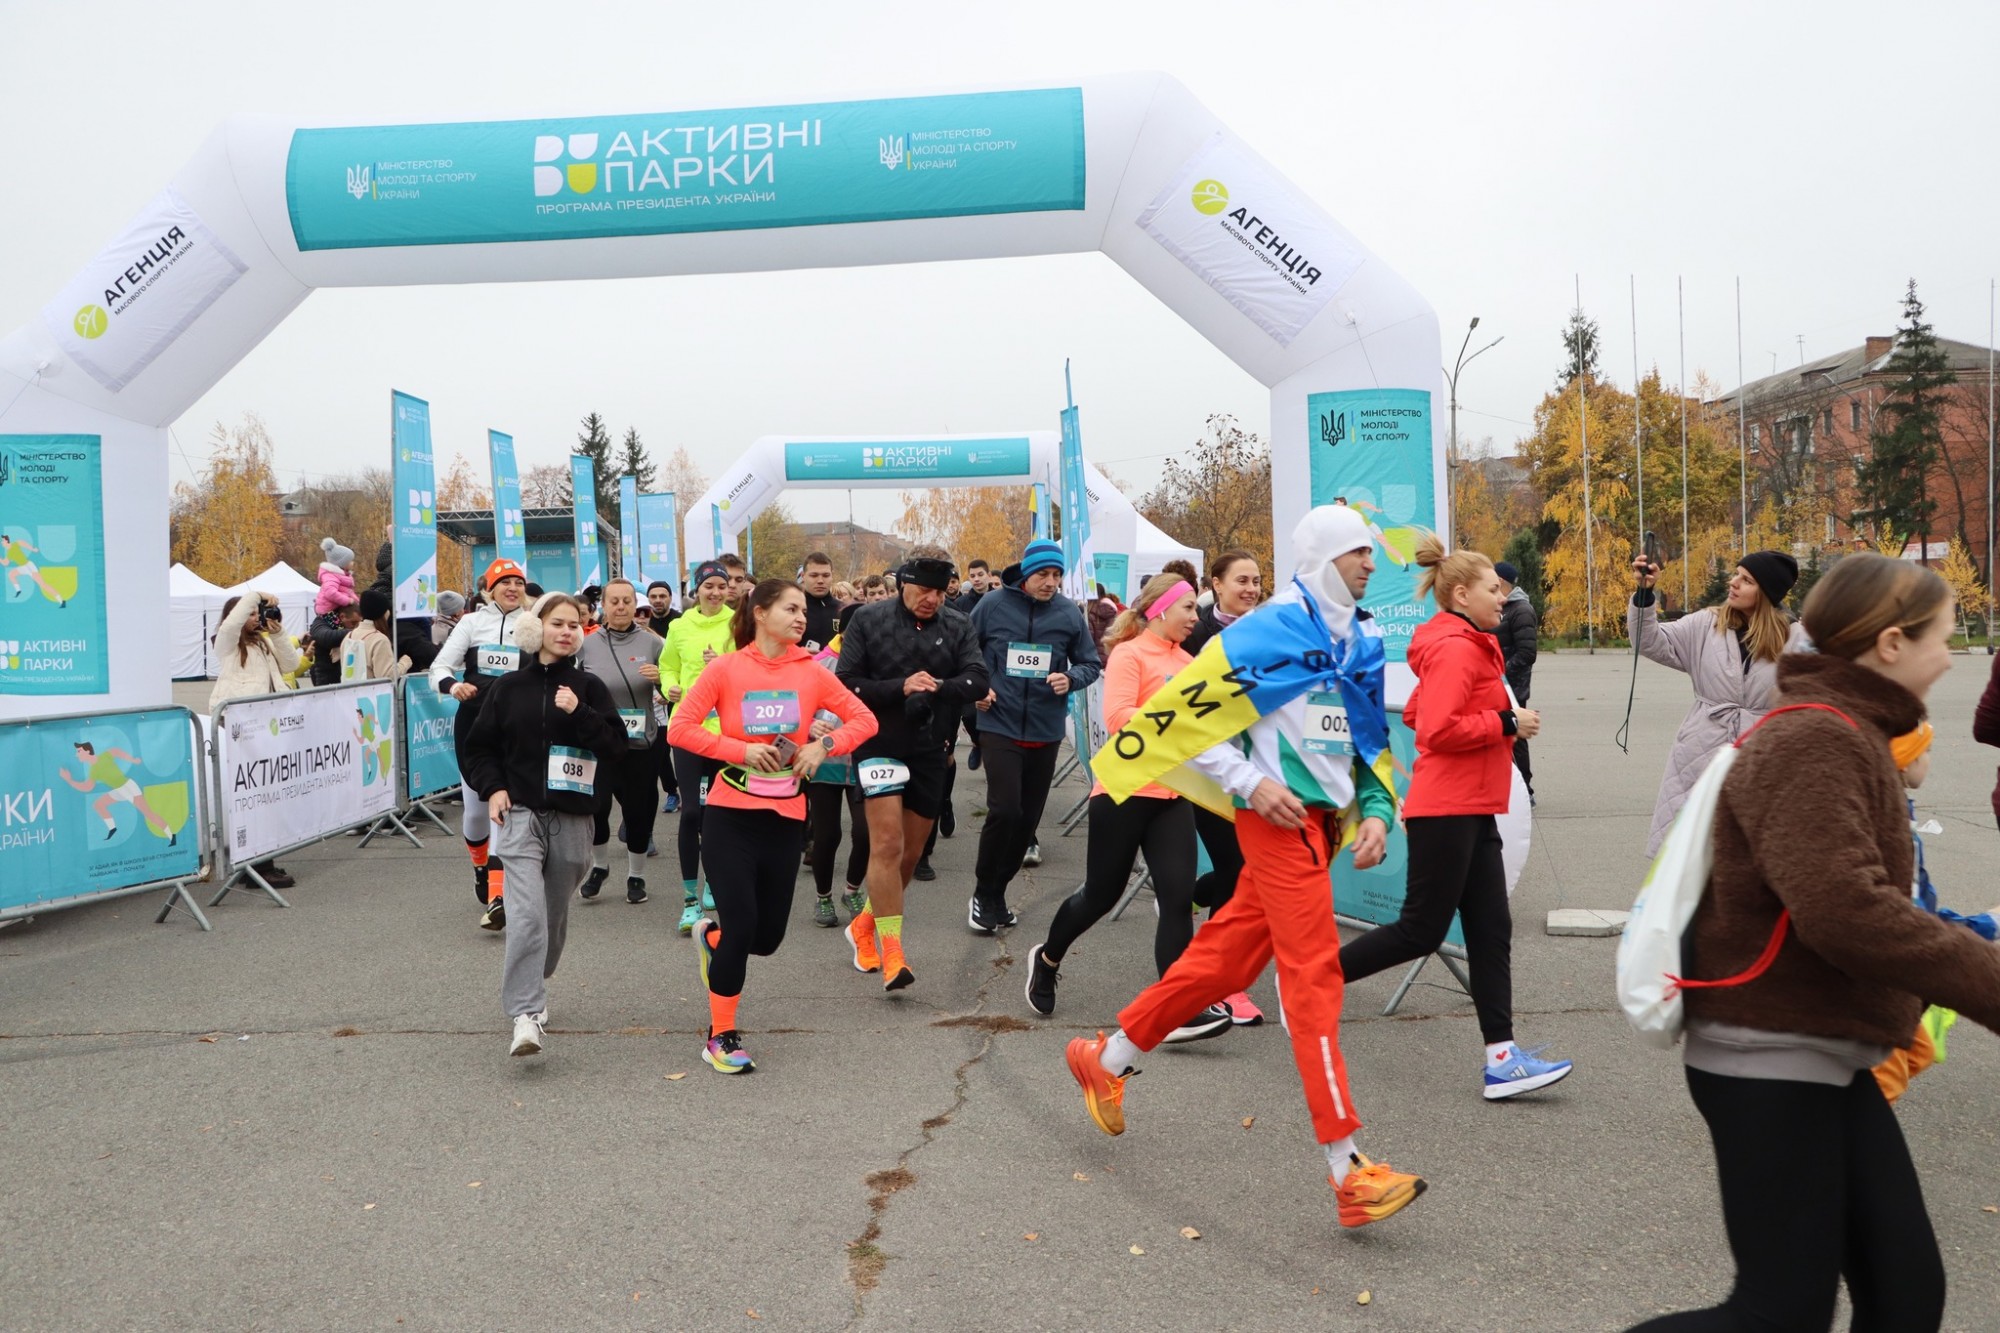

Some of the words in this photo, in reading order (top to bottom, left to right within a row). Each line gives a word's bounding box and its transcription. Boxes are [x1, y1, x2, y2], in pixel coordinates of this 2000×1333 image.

[605, 119, 822, 158] АКТИВНІ
[912, 128, 991, 141] МІНІСТЕРСТВО
[912, 144, 956, 155] МОЛОДІ
[958, 142, 972, 152] ТА
[974, 140, 1018, 152] СПОРТУ
[378, 159, 453, 171] МІНІСТЕРСТВО
[912, 158, 957, 170] УКРАЇНИ
[378, 174, 418, 185] МОЛОДІ
[421, 174, 434, 183] ТА
[435, 172, 477, 183] СПОРТУ
[605, 153, 775, 193] ПАРКИ
[378, 189, 420, 200] УКРАЇНИ
[536, 201, 613, 215] ПРОГРАМА
[616, 195, 711, 211] ПРЕЗИДЕНТА
[715, 191, 776, 205] УКРАЇНИ
[1228, 207, 1322, 286] АГЕНЦІЯ
[1220, 220, 1255, 251] МАСОВОГО
[1254, 249, 1280, 273] СПОРТУ
[1279, 270, 1307, 296] УКРАЇНИ
[104, 225, 186, 306] АГЕНЦІЯ
[114, 285, 147, 316] МАСОВОГО
[146, 264, 170, 287] СПОРТУ
[168, 241, 194, 266] УКРАЇНИ
[1360, 408, 1422, 418] МІНІСТЕРСТВО
[1361, 421, 1399, 430] МОЛОДІ
[1361, 433, 1374, 442] ТА
[1376, 432, 1410, 442] СПОРТУ
[20, 453, 86, 461] МІНІСТЕРСТВО
[886, 446, 952, 456] АКТИВНІ
[885, 456, 938, 467] ПАРКИ
[20, 464, 55, 473] МОЛОДІ
[32, 476, 69, 484] СПОРТУ
[728, 472, 754, 500] АГЕНЦІЯ
[1368, 604, 1425, 618] АКТИВНІ
[1380, 624, 1415, 636] АРКИ
[23, 640, 86, 652] АКТИВНІ
[24, 658, 73, 670] ПАРКИ
[488, 655, 508, 665] 020
[1018, 654, 1040, 666] 058
[756, 705, 784, 718] 207
[280, 714, 304, 727] АГЕНЦІЯ
[234, 751, 301, 792] АКТИВНІ
[306, 740, 351, 775] ПАРКИ
[563, 762, 583, 777] 038
[871, 769, 894, 780] 027
[235, 791, 280, 812] ПРОГРАМА
[282, 778, 324, 800] ПРЕЗИДЕНТА
